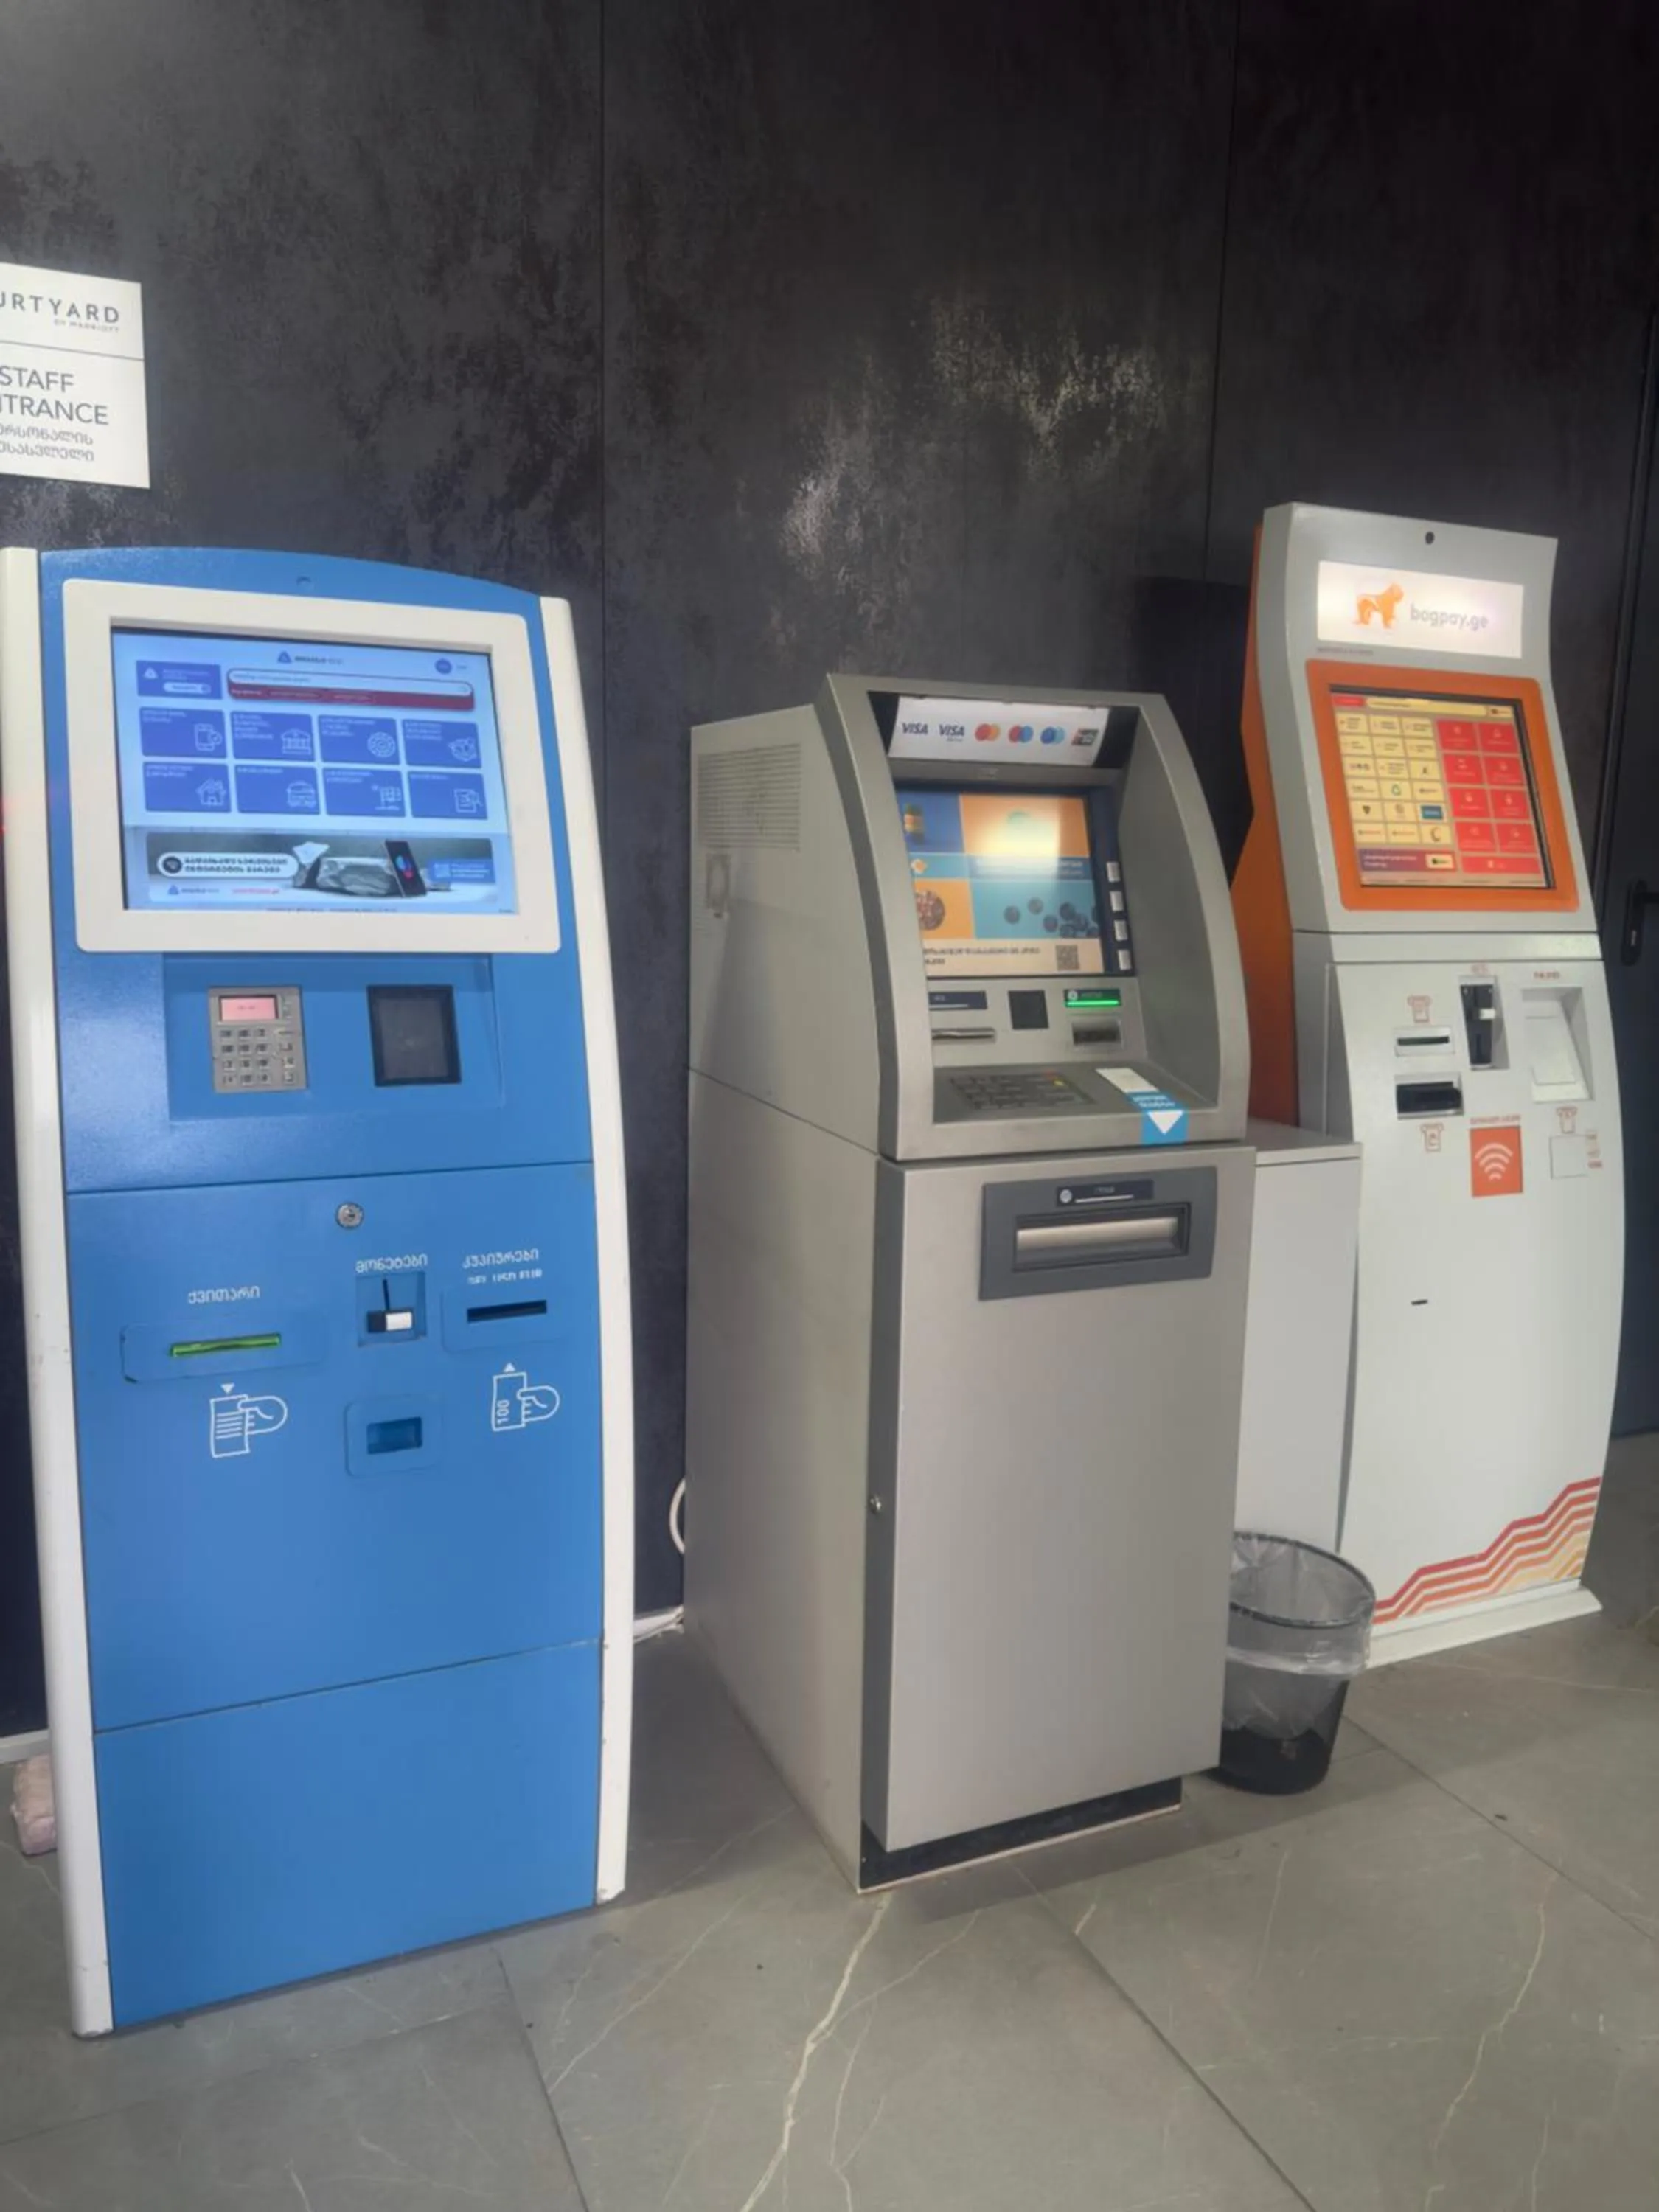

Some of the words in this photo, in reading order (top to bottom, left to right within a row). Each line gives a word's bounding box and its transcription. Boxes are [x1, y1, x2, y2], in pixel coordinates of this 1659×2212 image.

[0, 365, 74, 392] STAFF
[0, 393, 109, 425] TRANCE
[1410, 604, 1489, 631] bogpay.ge
[902, 723, 928, 735] VISA
[939, 724, 965, 737] VISA
[497, 1399, 509, 1425] 100
